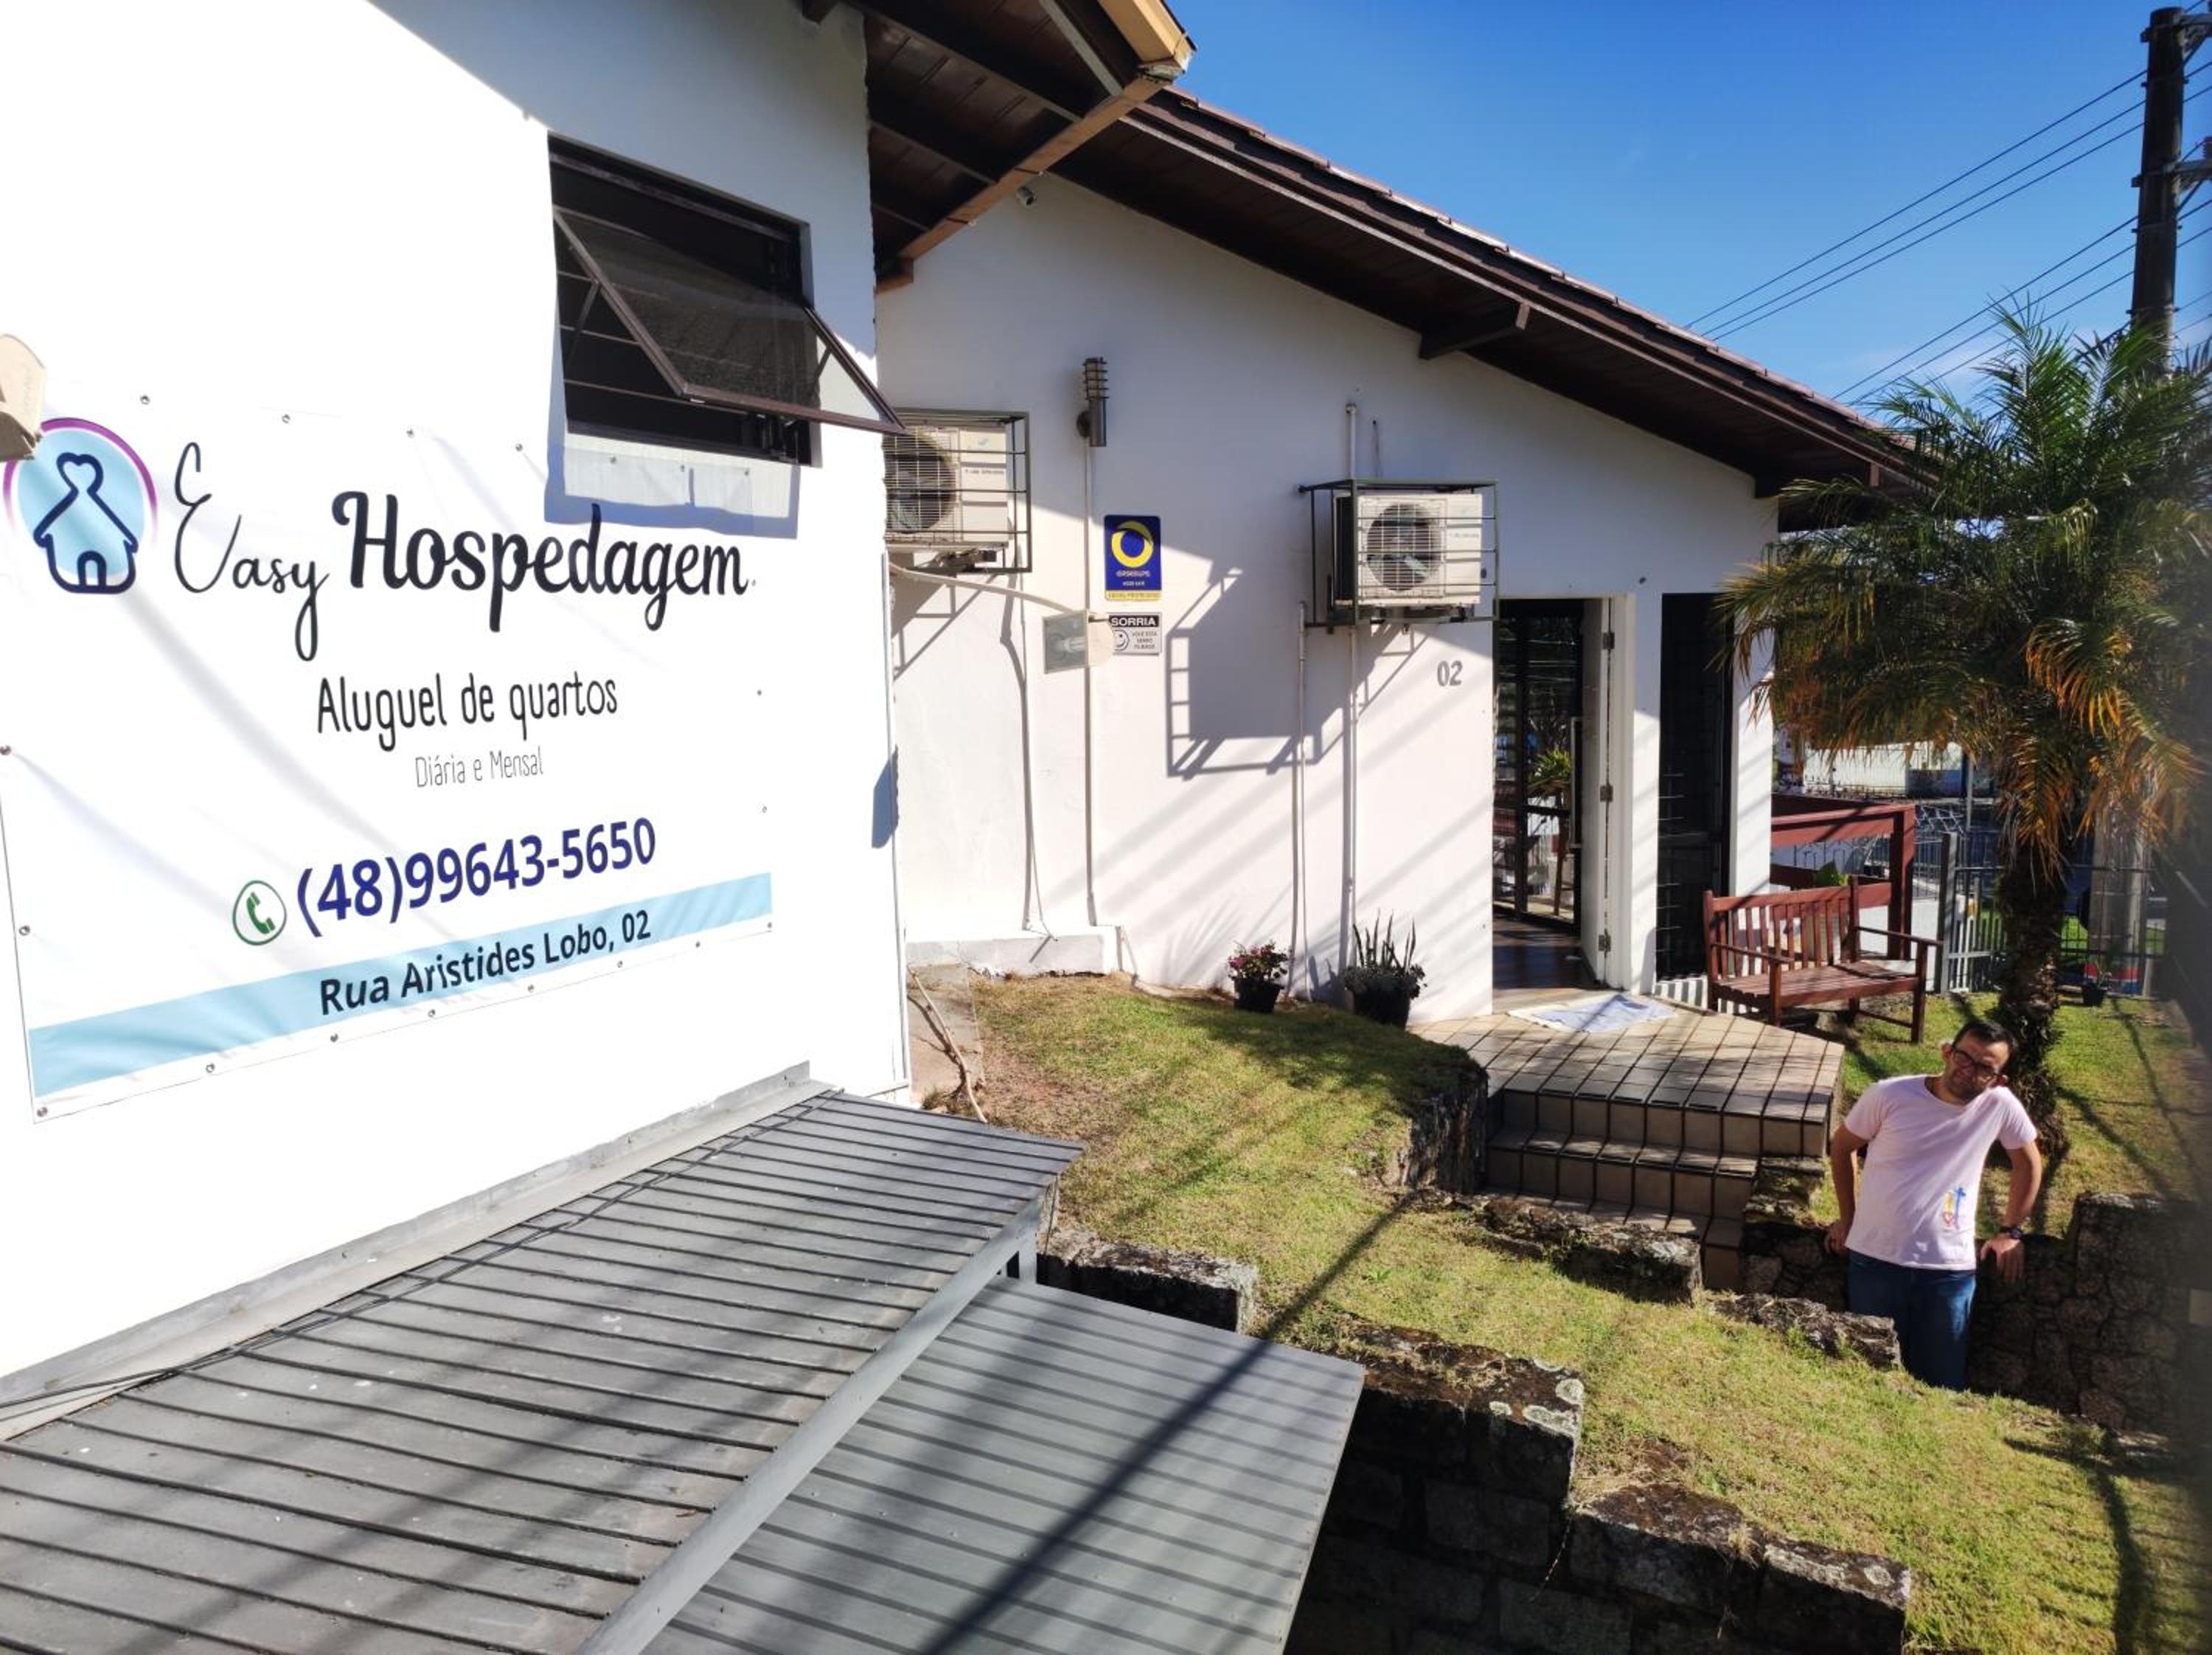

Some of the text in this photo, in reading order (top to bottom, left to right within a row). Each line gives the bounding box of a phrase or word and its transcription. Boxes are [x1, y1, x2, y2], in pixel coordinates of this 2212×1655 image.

[175, 443, 749, 662] Easy Hospedagem
[1111, 617, 1156, 627] SORRIA
[318, 671, 617, 752] Aluguel de quartos
[1437, 660, 1464, 687] 02
[414, 745, 543, 788] Diária e Mensal
[297, 817, 655, 937] (48)99643-5650
[320, 909, 651, 1016] Rua Aristides Lobo, 02
